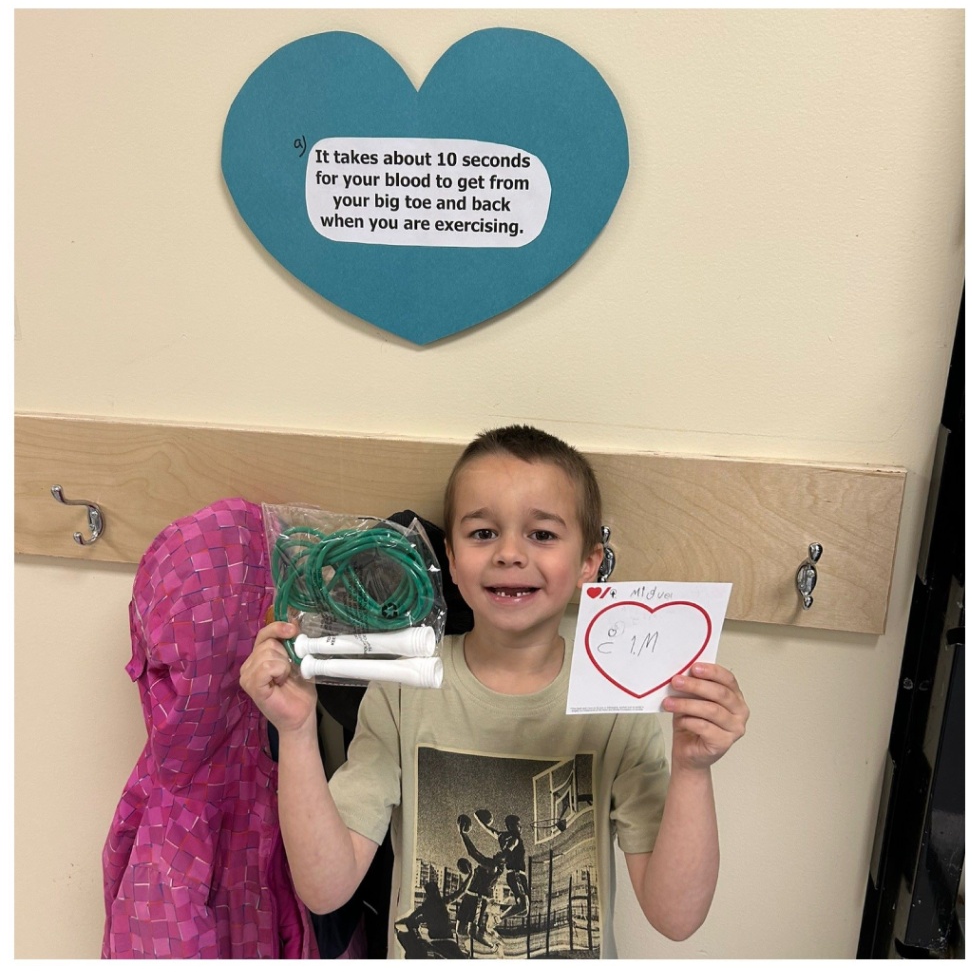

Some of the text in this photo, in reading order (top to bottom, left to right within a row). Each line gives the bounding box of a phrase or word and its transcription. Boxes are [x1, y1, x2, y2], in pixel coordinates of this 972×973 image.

[293, 135, 307, 158] a)
[315, 149, 531, 168] It takes about 10 seconds
[315, 170, 529, 192] for your blood to get from
[333, 193, 511, 212] your big toe and back
[320, 213, 524, 237] when you are exercising.
